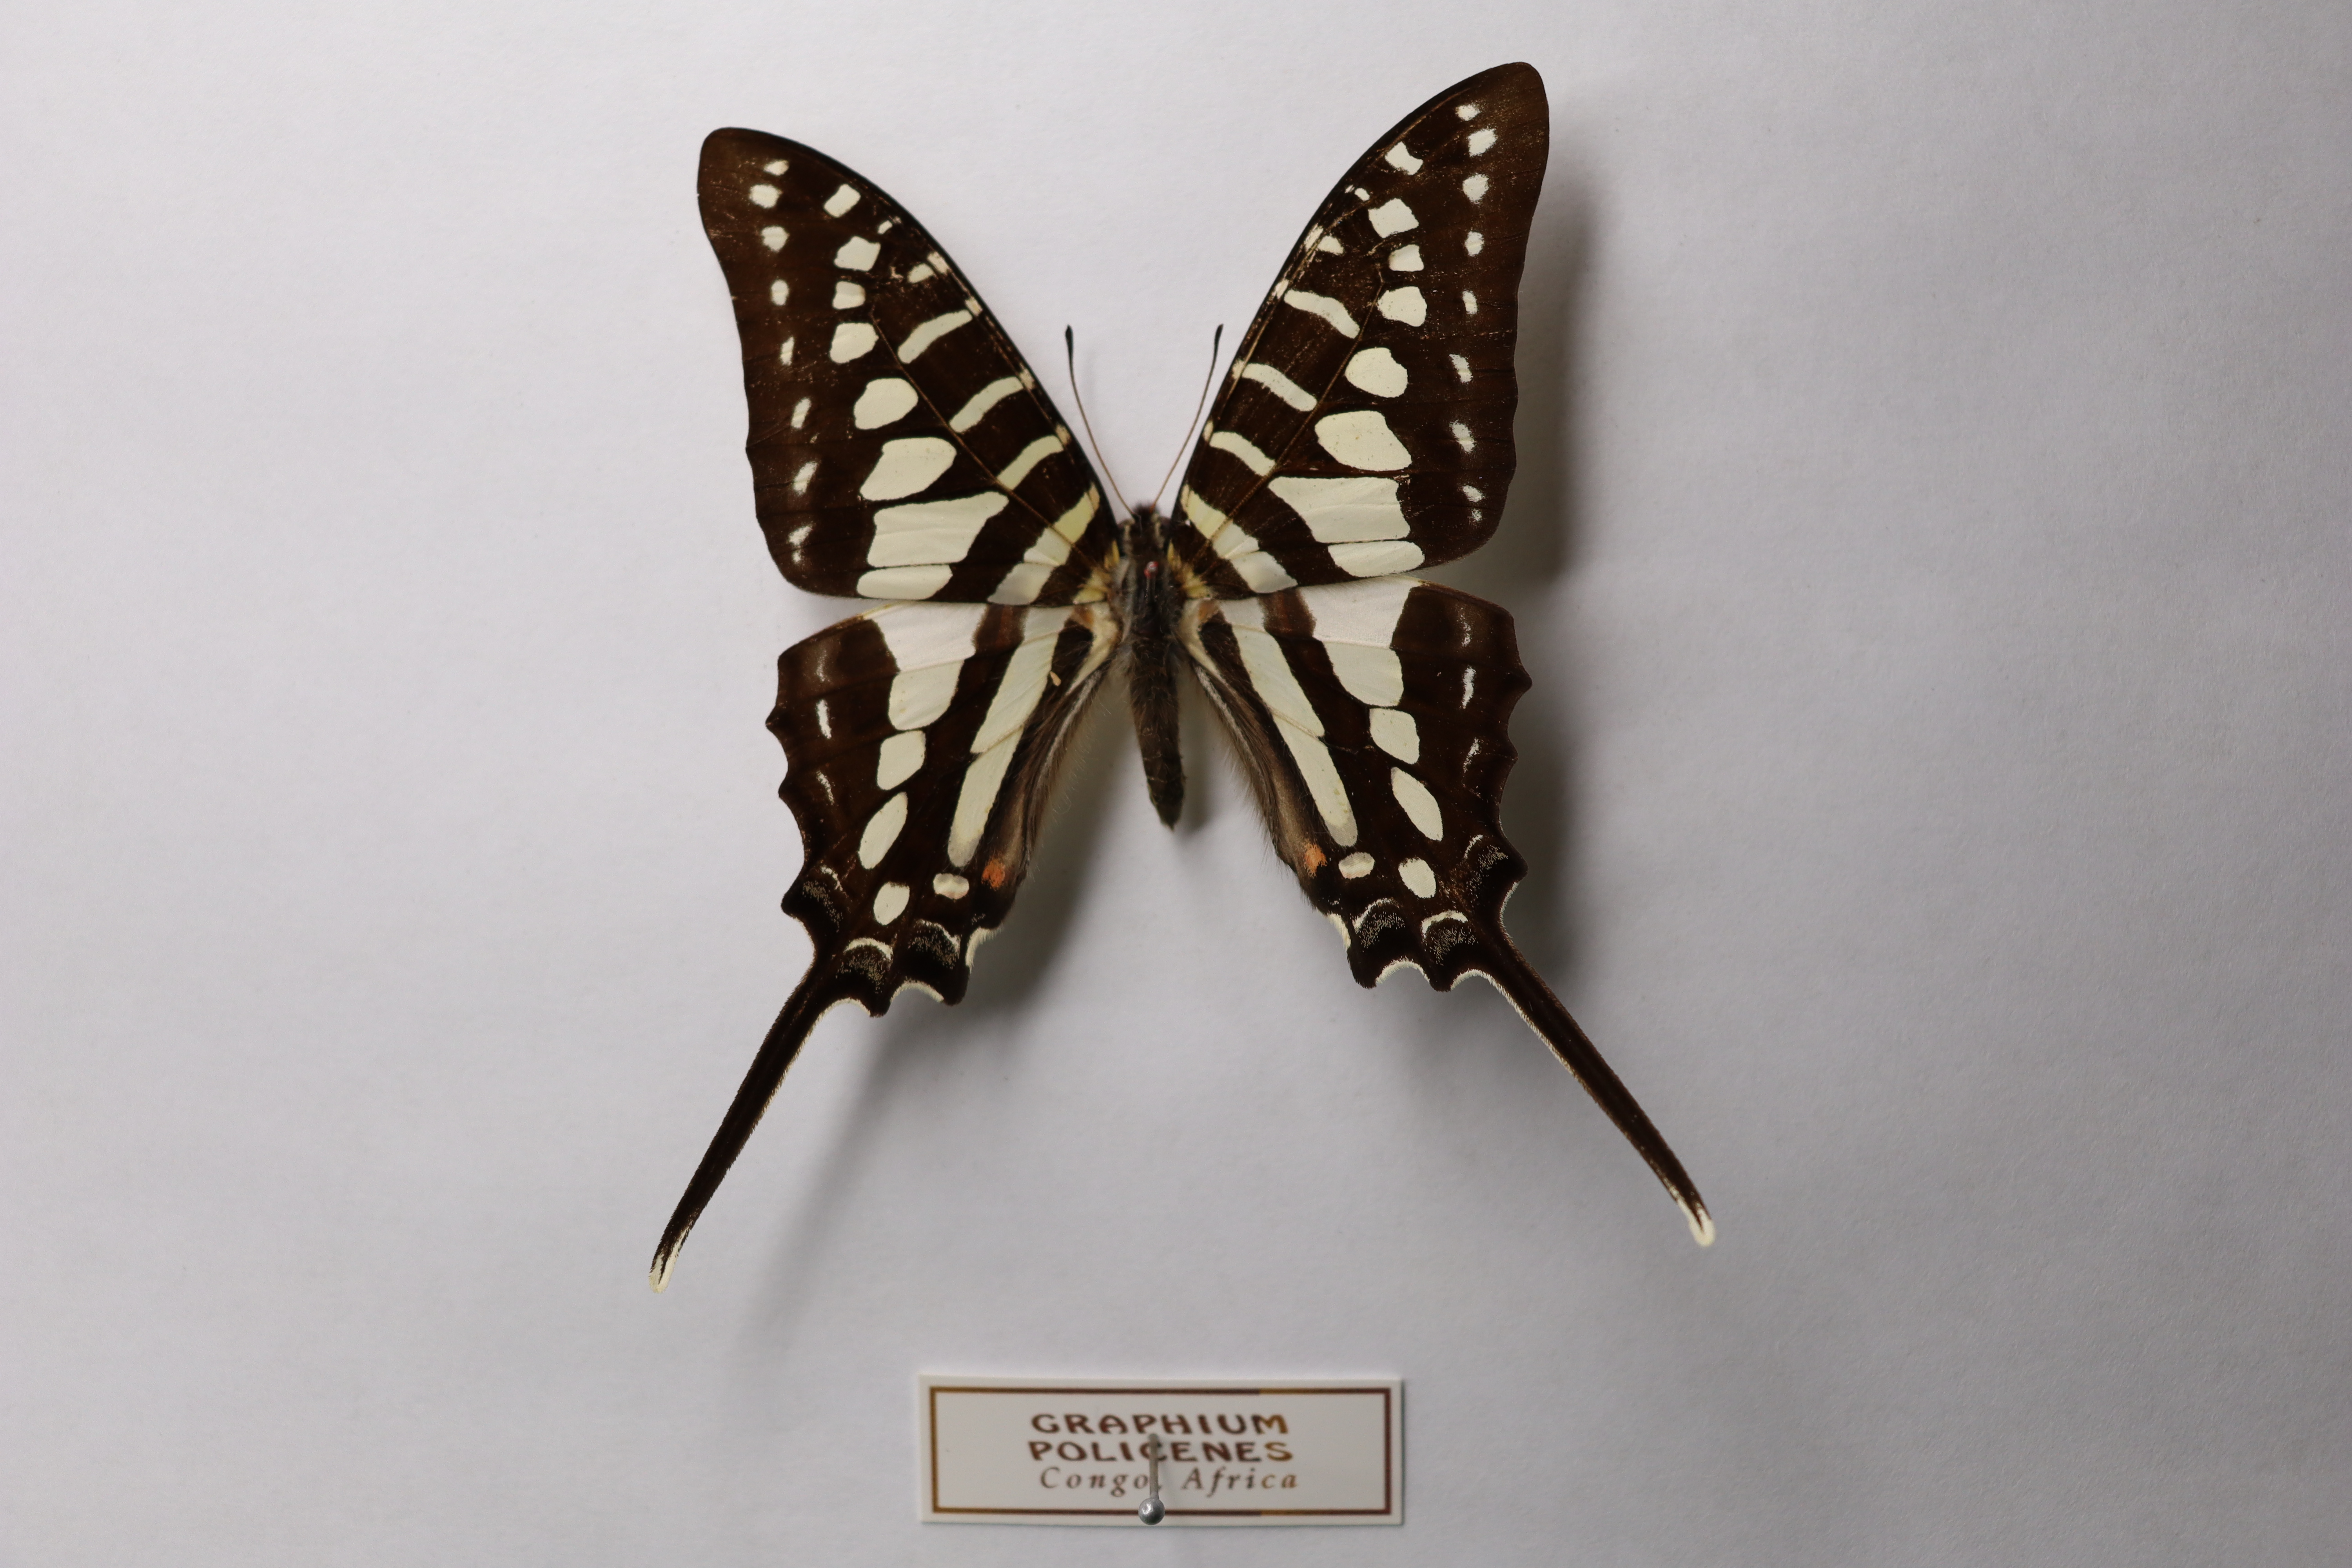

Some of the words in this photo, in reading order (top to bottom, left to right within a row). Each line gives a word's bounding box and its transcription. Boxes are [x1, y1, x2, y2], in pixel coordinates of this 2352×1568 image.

[1032, 1414, 1288, 1434] GRAPHIUM
[1029, 1441, 1292, 1461] POLICENES
[1181, 1466, 1297, 1497] Africa
